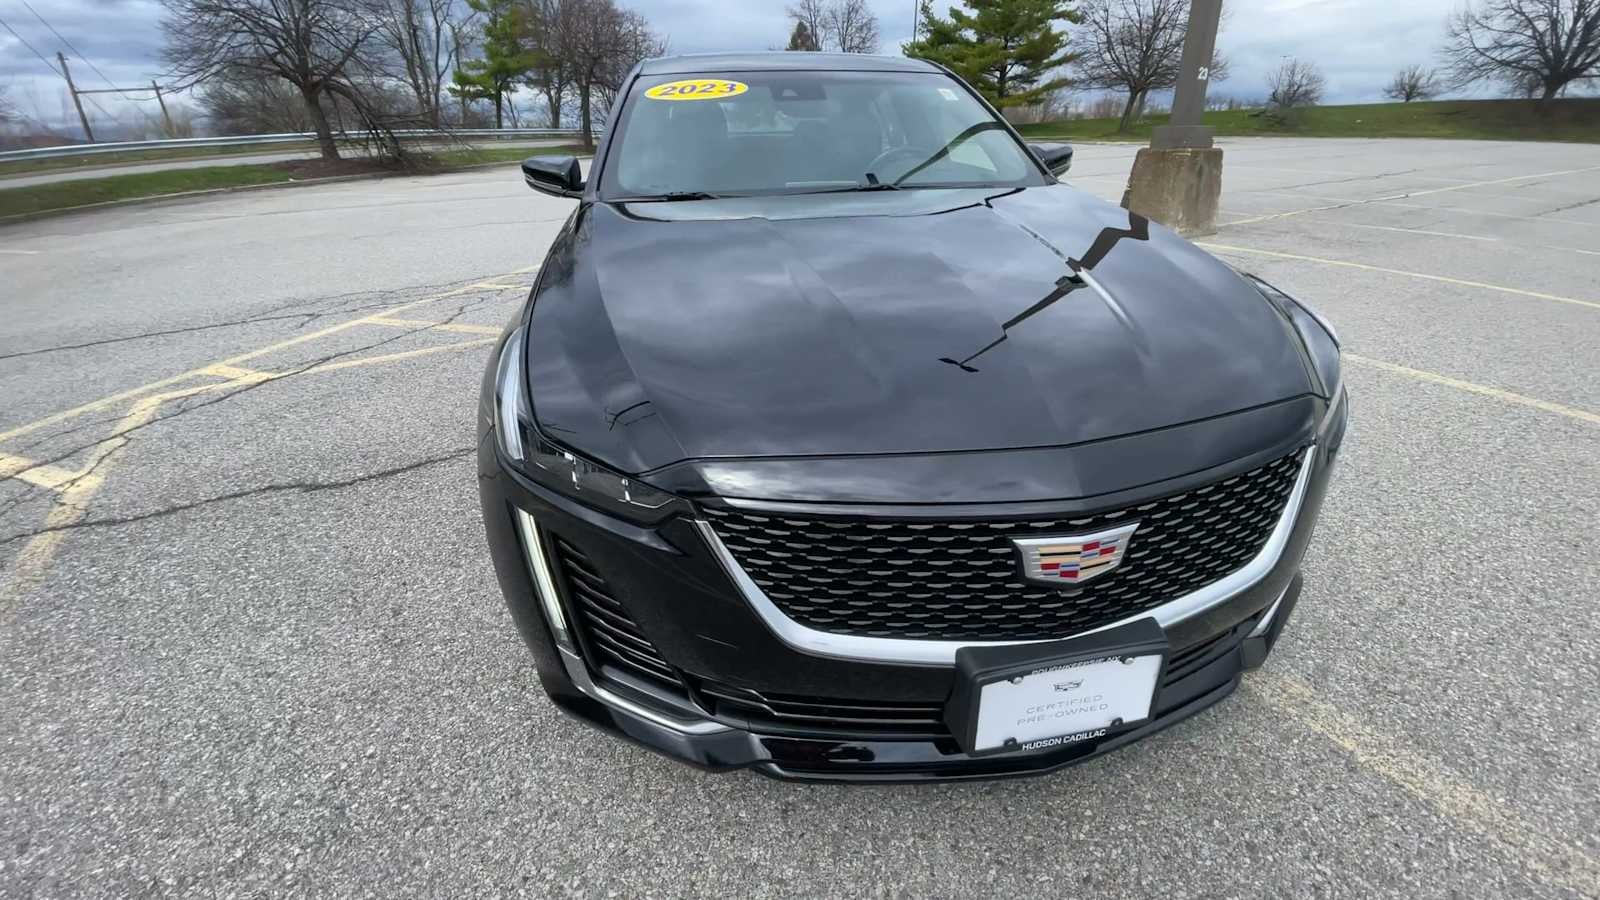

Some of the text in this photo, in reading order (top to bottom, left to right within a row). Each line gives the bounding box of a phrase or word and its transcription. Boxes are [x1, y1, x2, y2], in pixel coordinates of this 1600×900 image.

[1197, 66, 1208, 80] 23
[659, 83, 737, 96] 2023
[1026, 695, 1103, 714] CERTIFIED
[1017, 703, 1108, 726] PRE-OWNED
[1022, 729, 1106, 751] HUDSON CADILLAC
